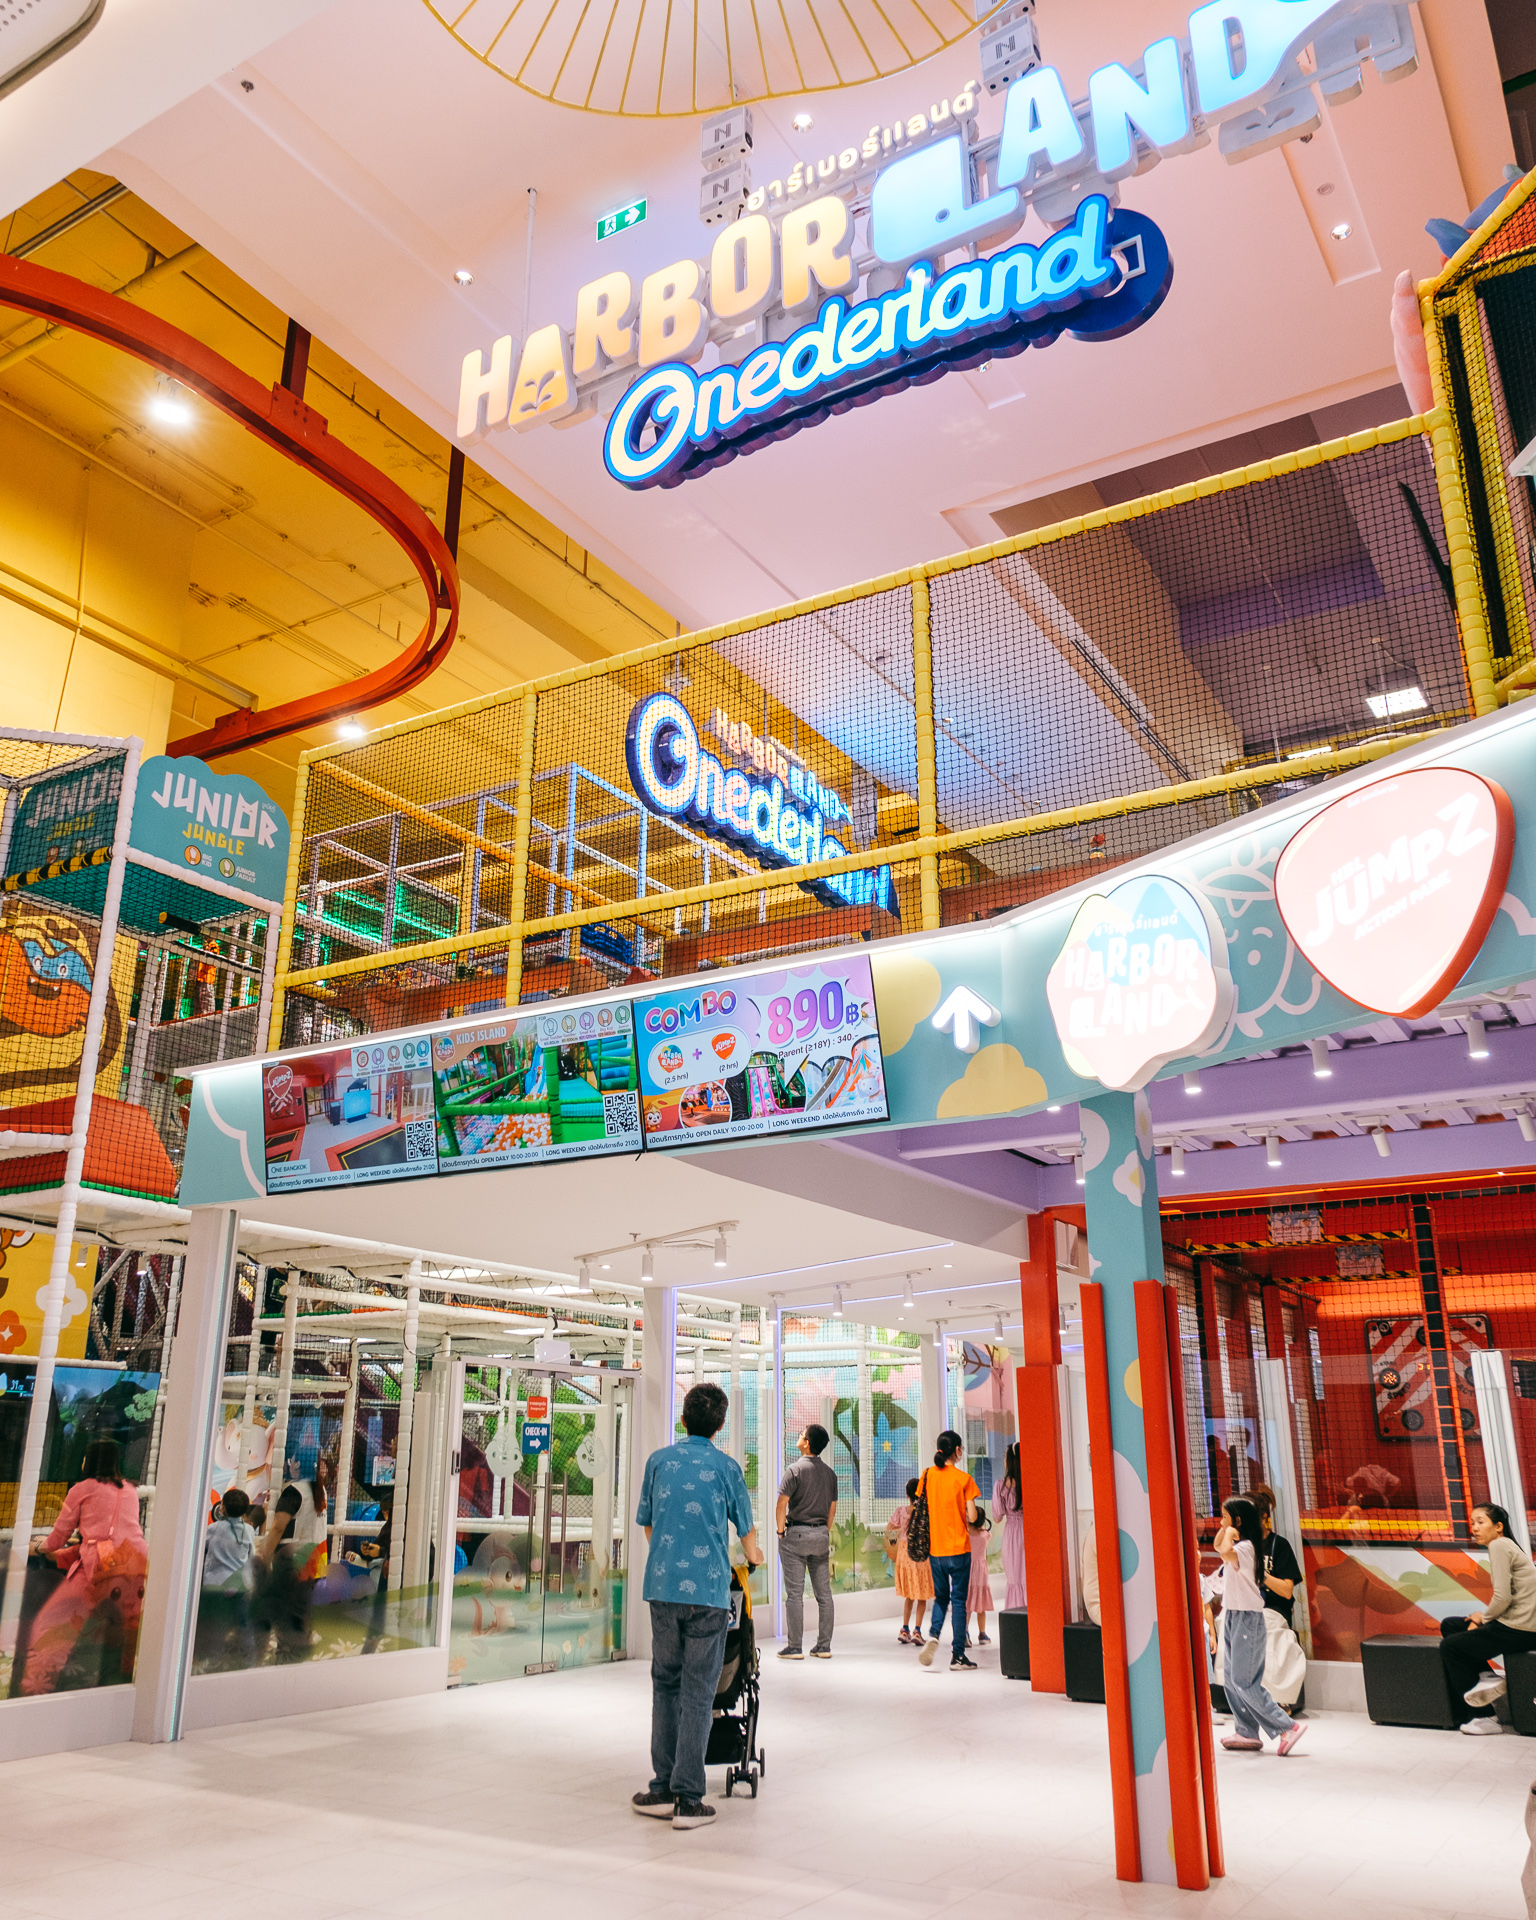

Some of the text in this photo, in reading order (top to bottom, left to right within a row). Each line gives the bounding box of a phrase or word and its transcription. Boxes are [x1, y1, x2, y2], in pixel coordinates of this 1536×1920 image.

[457, 0, 1345, 439] HARBOR LAND
[606, 194, 1113, 482] Onederland
[152, 771, 278, 849] JUNIOR
[182, 823, 245, 856] JUNGLE
[201, 859, 212, 867] KID
[202, 853, 213, 862] BIG
[235, 866, 256, 877] JUNIOR
[1354, 869, 1452, 940] ACTION PARK
[1064, 934, 1199, 991] HARBOR
[645, 990, 737, 1033] COMBO
[1068, 983, 1207, 1038] LAND
[456, 1032, 474, 1044] KIDS
[477, 1026, 506, 1041] ISLAND
[778, 1046, 804, 1058] Parent
[719, 1061, 738, 1073] (2 hrs)
[676, 1072, 688, 1080] hrs)
[772, 1119, 789, 1127] LONG
[790, 1116, 820, 1124] WEEKEND
[713, 1128, 729, 1136] DAILY
[284, 1164, 307, 1172] BANGKOK
[525, 1426, 548, 1436] CHECK-IN
